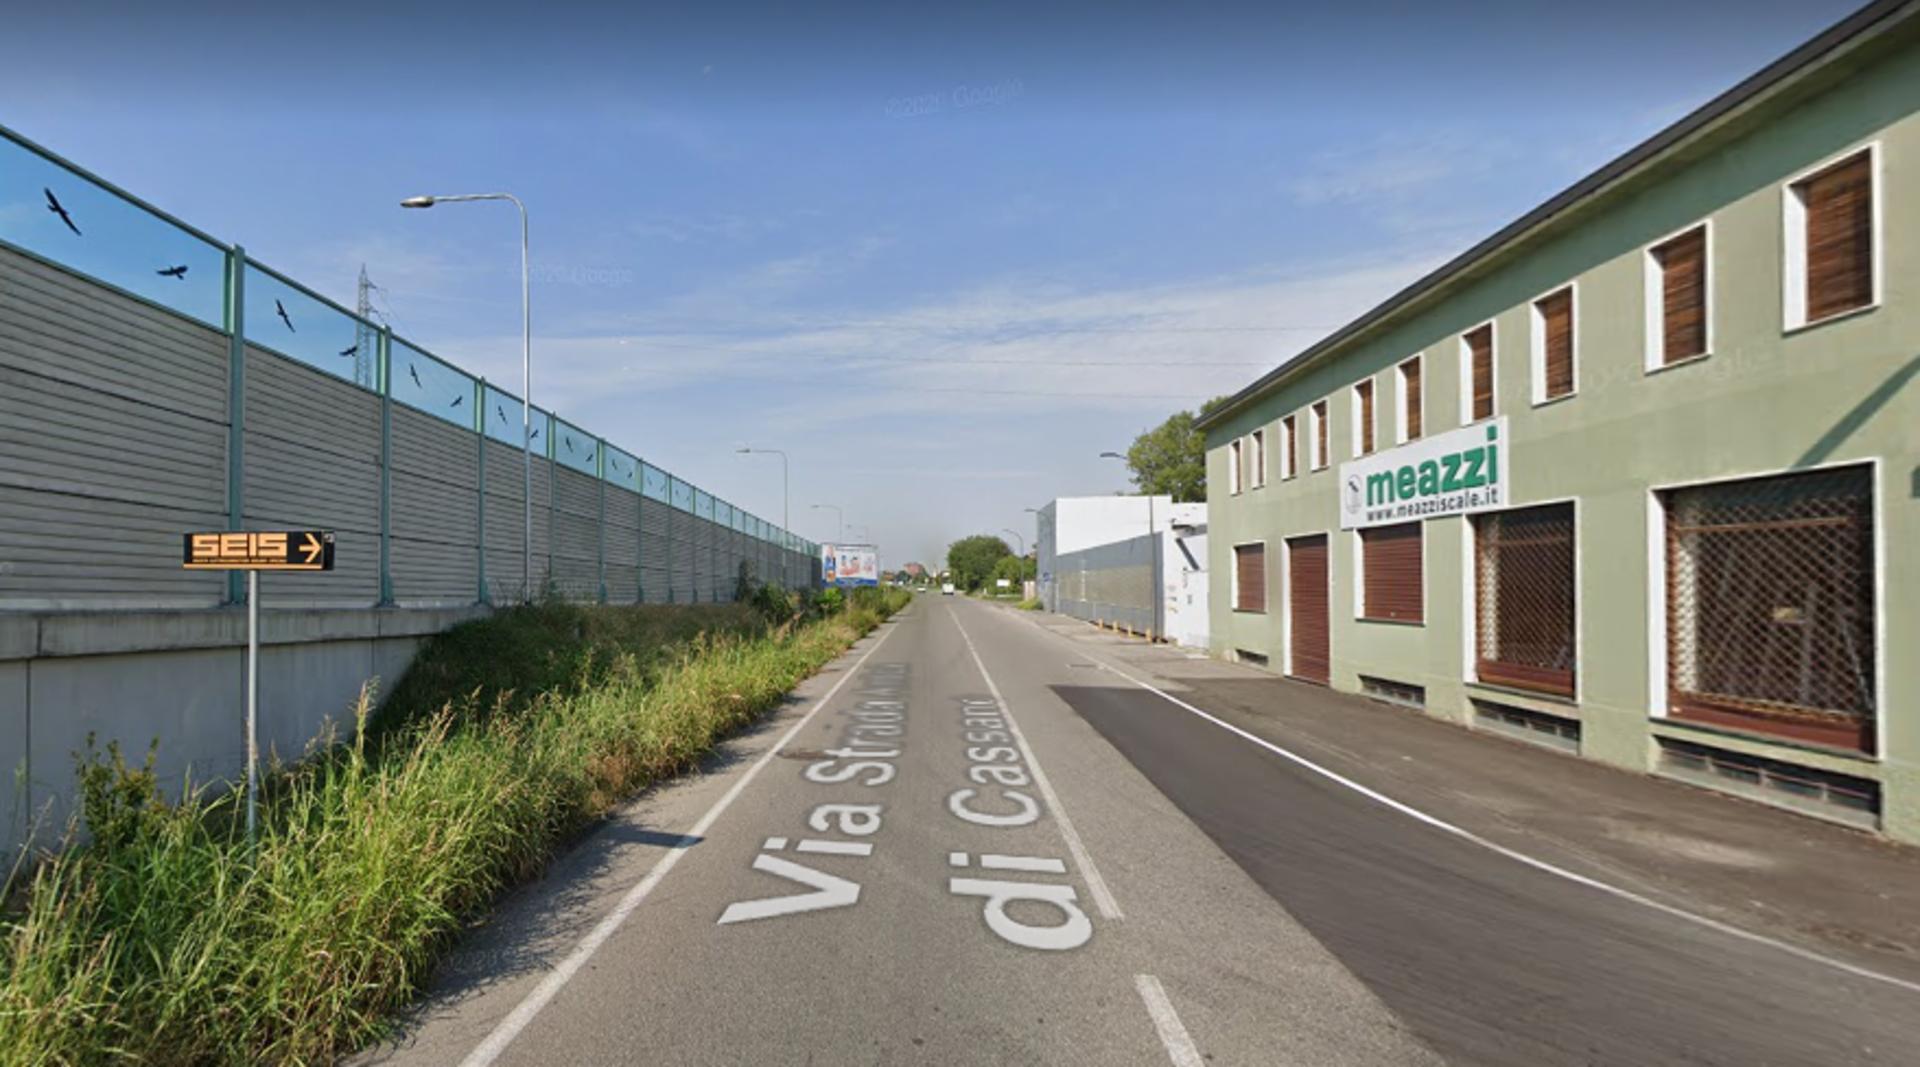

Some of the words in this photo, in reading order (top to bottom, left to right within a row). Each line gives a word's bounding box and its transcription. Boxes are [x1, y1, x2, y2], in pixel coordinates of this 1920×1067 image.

[1366, 425, 1498, 507] meazzi
[1366, 488, 1499, 522] www.meazziscale.it
[192, 532, 287, 557] SEIS
